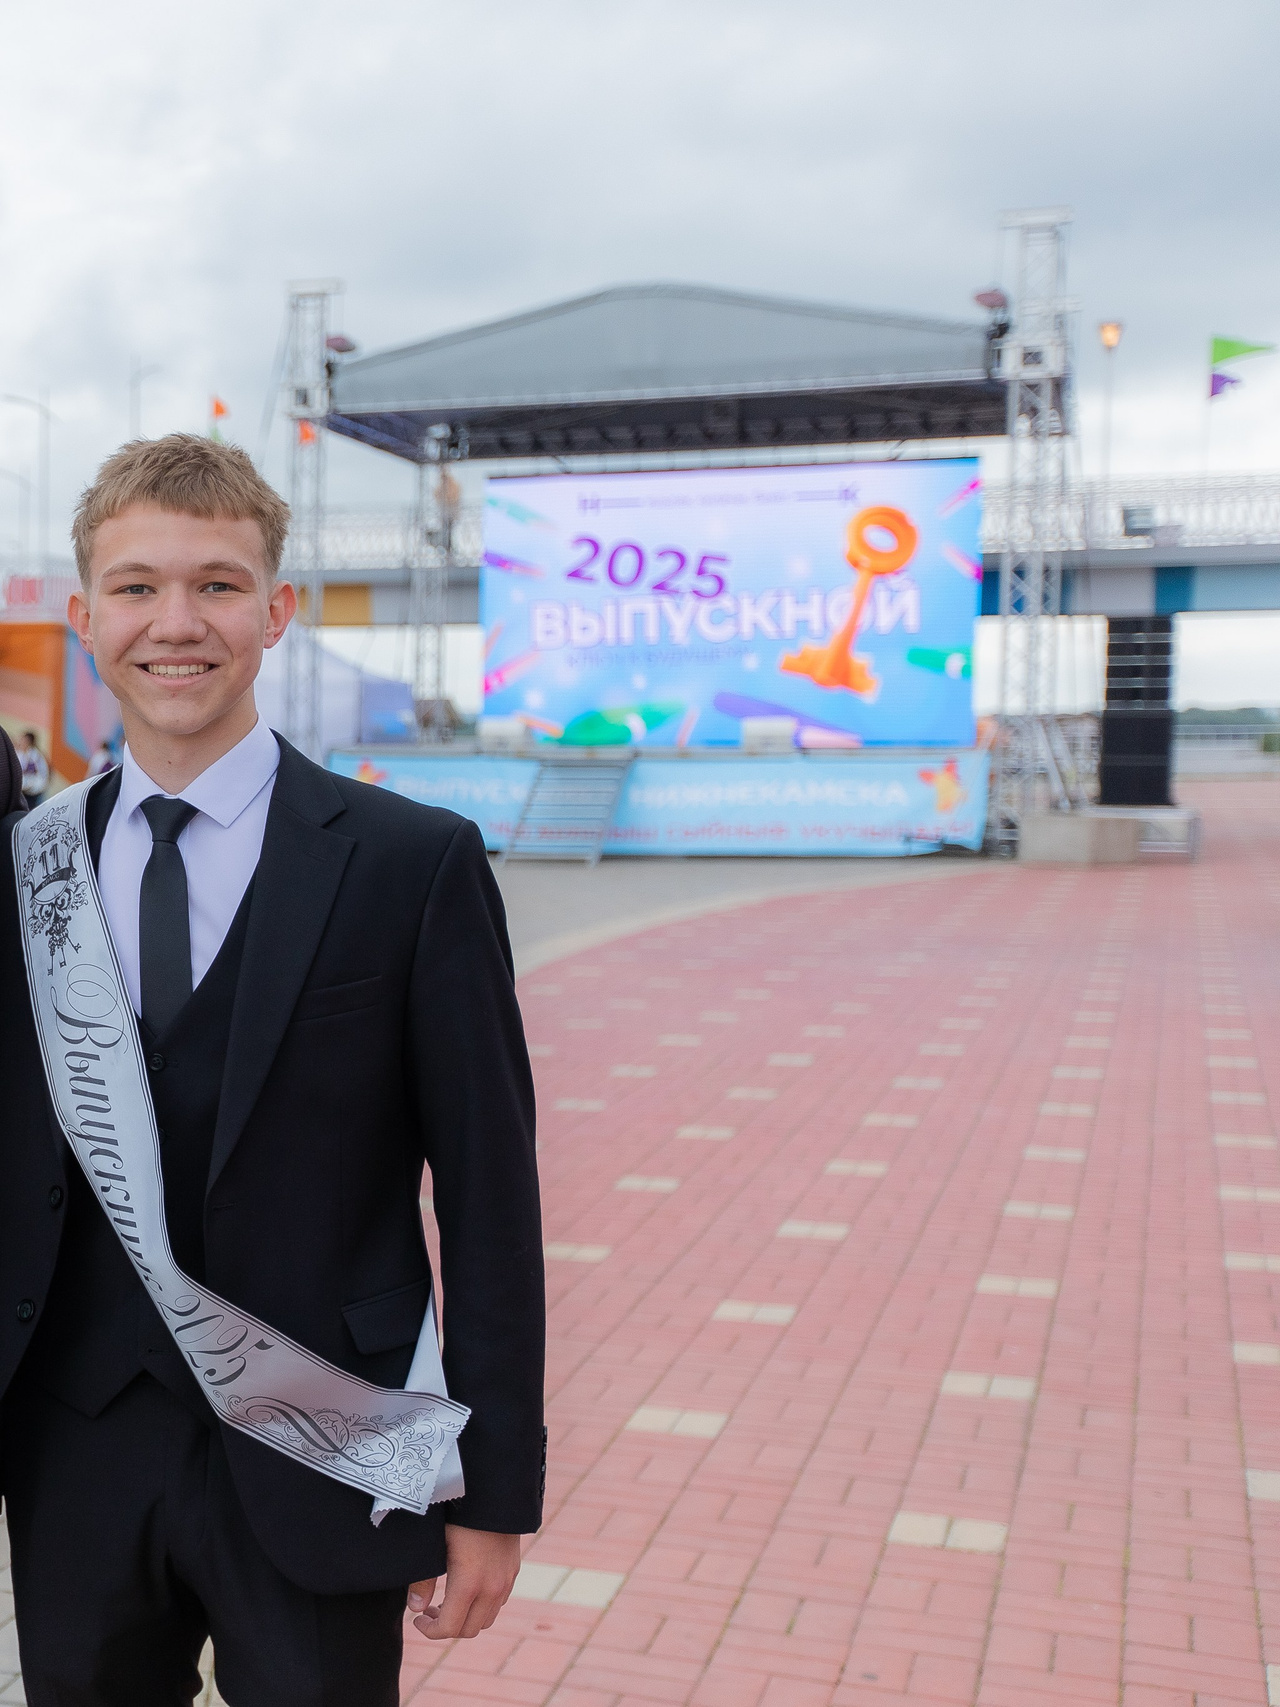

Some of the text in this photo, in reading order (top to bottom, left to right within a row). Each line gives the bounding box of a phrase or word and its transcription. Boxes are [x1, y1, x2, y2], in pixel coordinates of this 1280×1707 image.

[566, 535, 730, 599] 2025
[532, 569, 921, 649] ВЫПУСКНОЙ
[38, 843, 61, 879] 11
[156, 1294, 275, 1386] 2025
